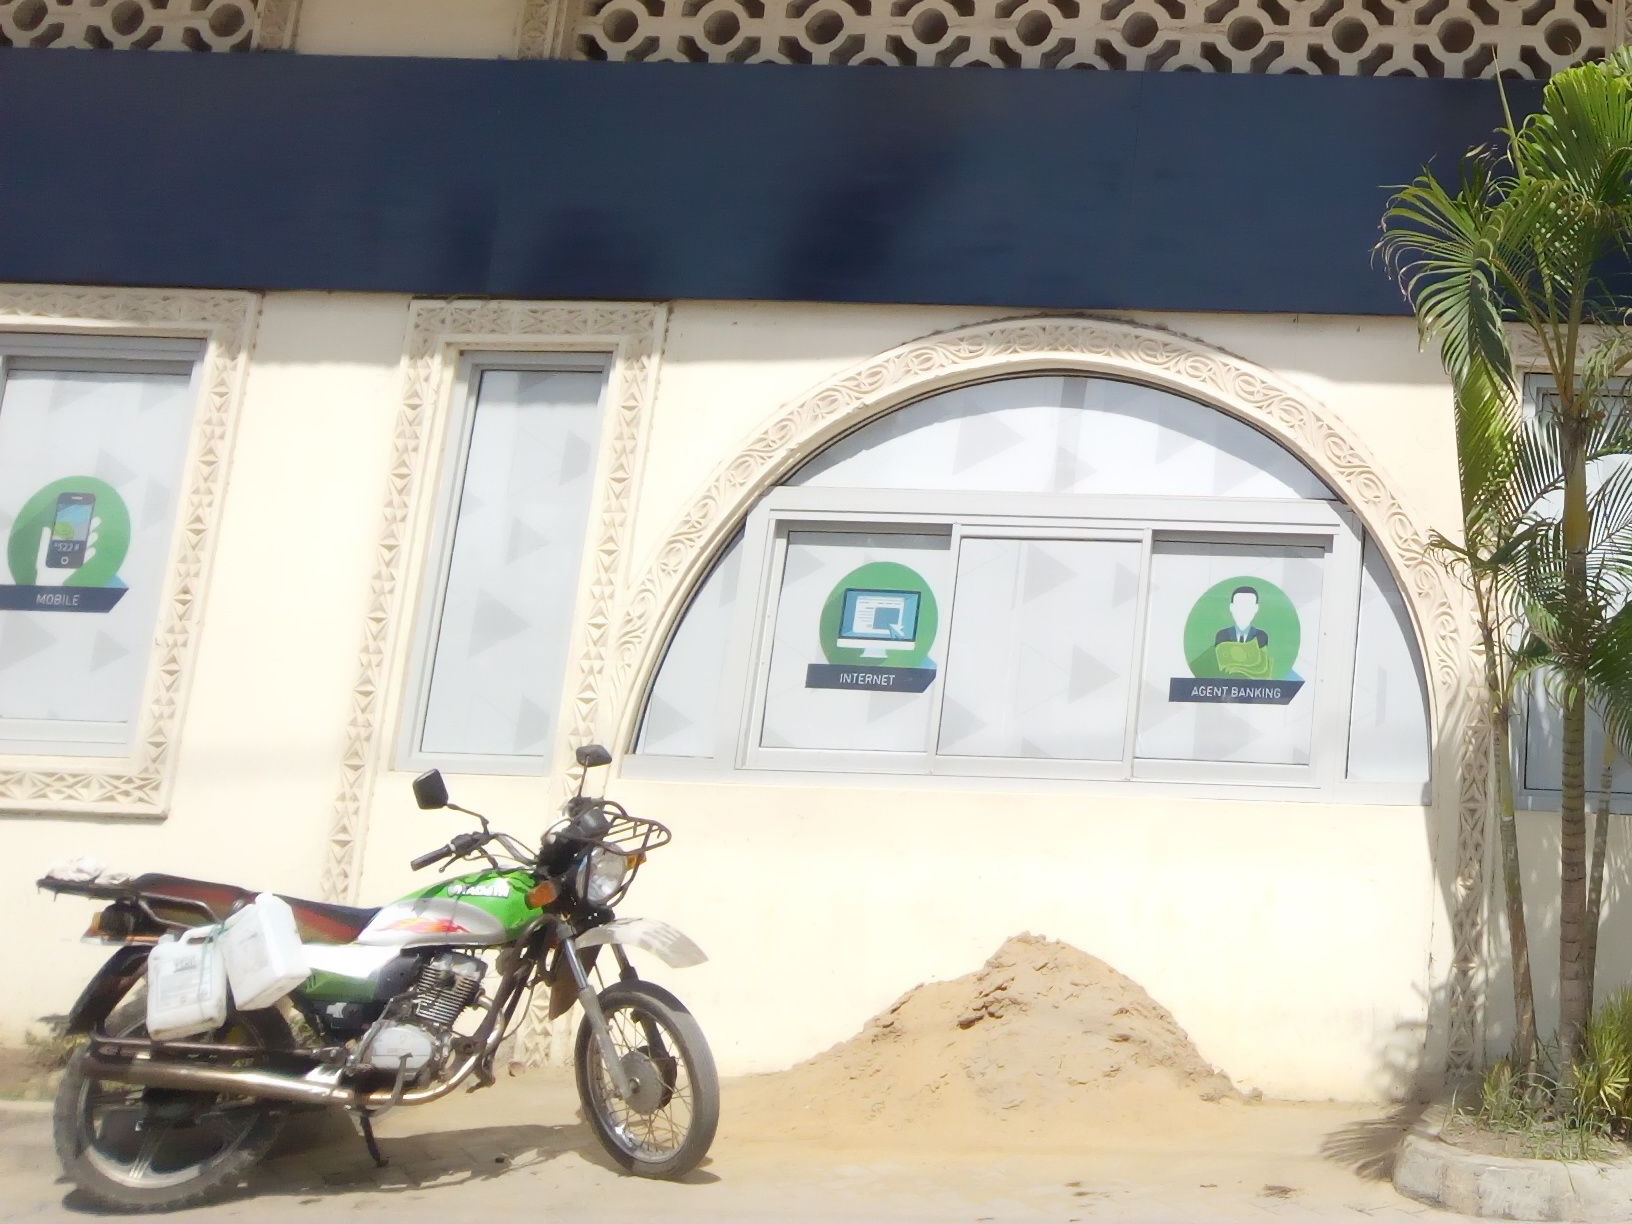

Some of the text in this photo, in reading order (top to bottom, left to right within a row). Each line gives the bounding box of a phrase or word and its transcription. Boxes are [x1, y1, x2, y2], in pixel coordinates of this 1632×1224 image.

[36, 594, 80, 606] MOBILE
[839, 673, 896, 686] INTERNET
[1191, 685, 1281, 699] AGENT BANKING
